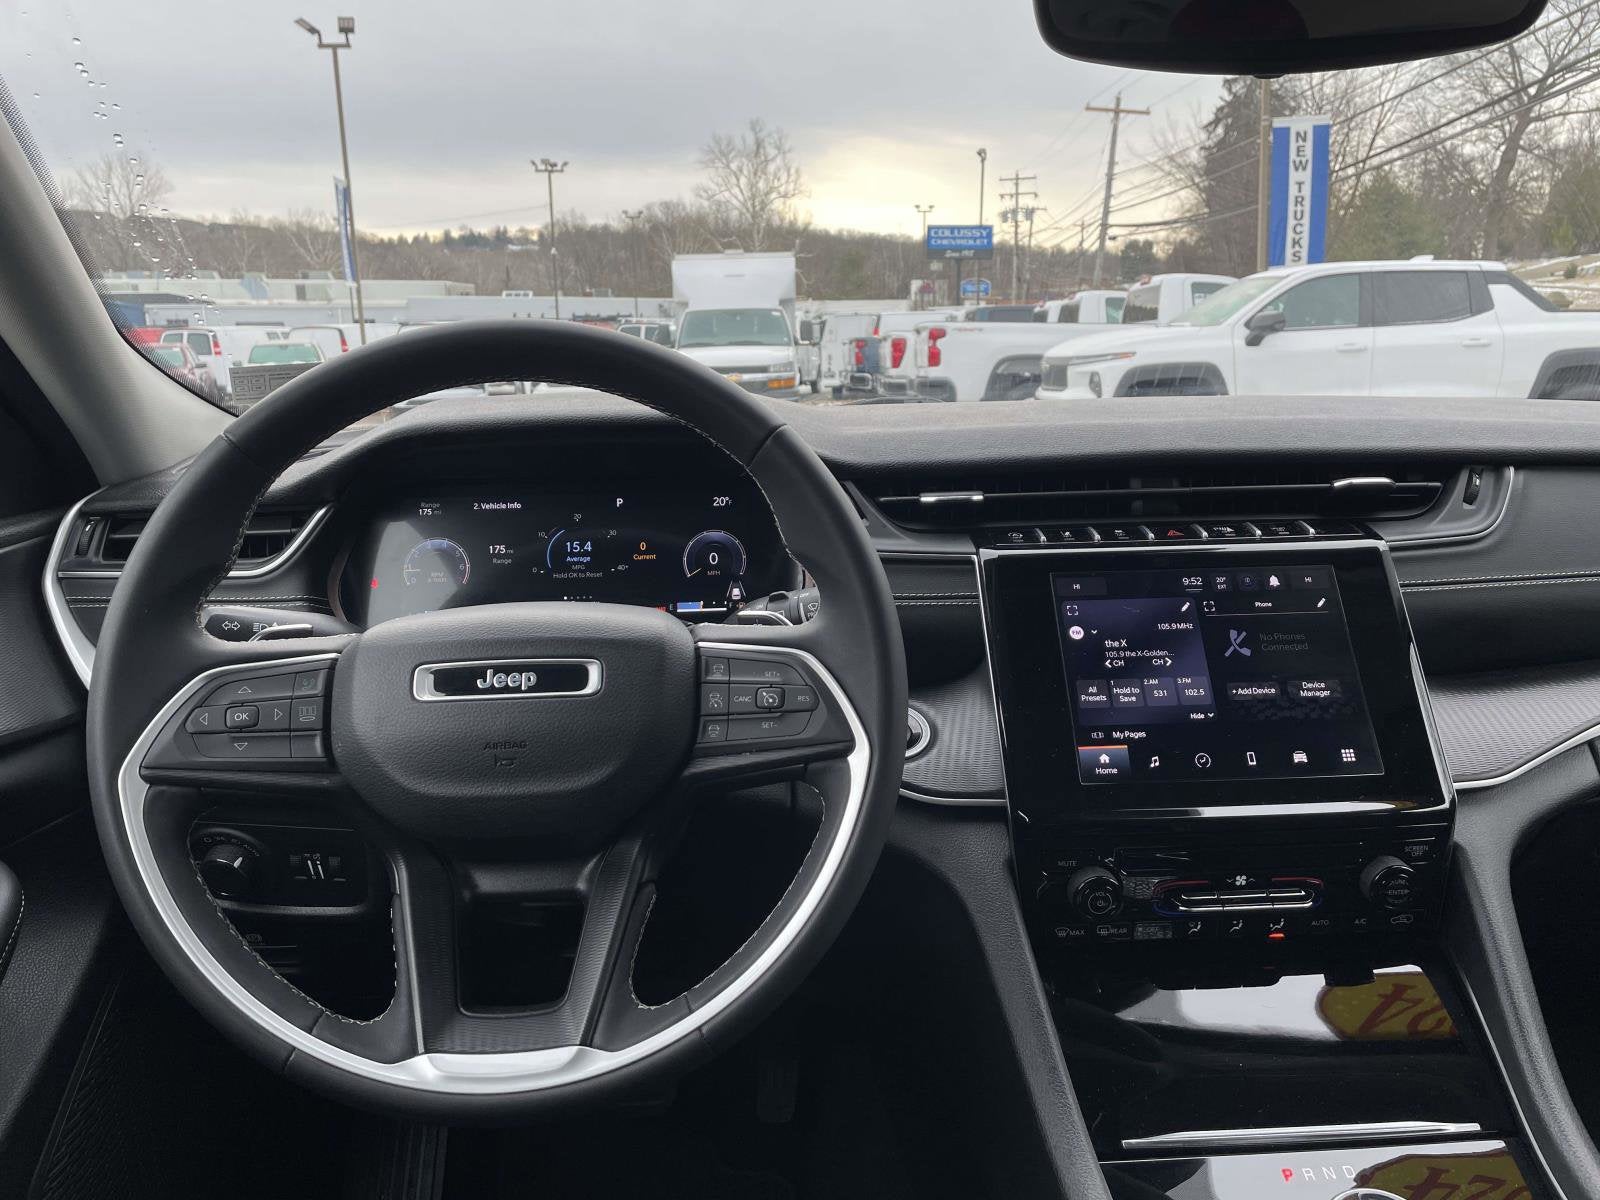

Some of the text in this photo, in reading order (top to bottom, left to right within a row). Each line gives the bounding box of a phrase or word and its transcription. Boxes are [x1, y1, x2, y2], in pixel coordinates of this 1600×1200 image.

[1291, 130, 1309, 262] NEW TRUCKS
[930, 228, 989, 237] COLUSSY
[616, 498, 624, 507] P
[489, 545, 505, 554] 175
[566, 541, 592, 552] 15.4
[709, 553, 718, 564] 0
[1182, 577, 1202, 586] 9:52
[1177, 622, 1194, 630] MHz
[1105, 639, 1128, 647] the X
[1152, 658, 1164, 666] CH
[476, 669, 537, 691] Jeep
[1300, 689, 1331, 698] Manager
[234, 712, 249, 721] OK
[1112, 731, 1146, 739] My Pages
[483, 741, 528, 751] AIRBAG
[1096, 767, 1118, 775] Home
[1281, 1165, 1356, 1183] P R N D
